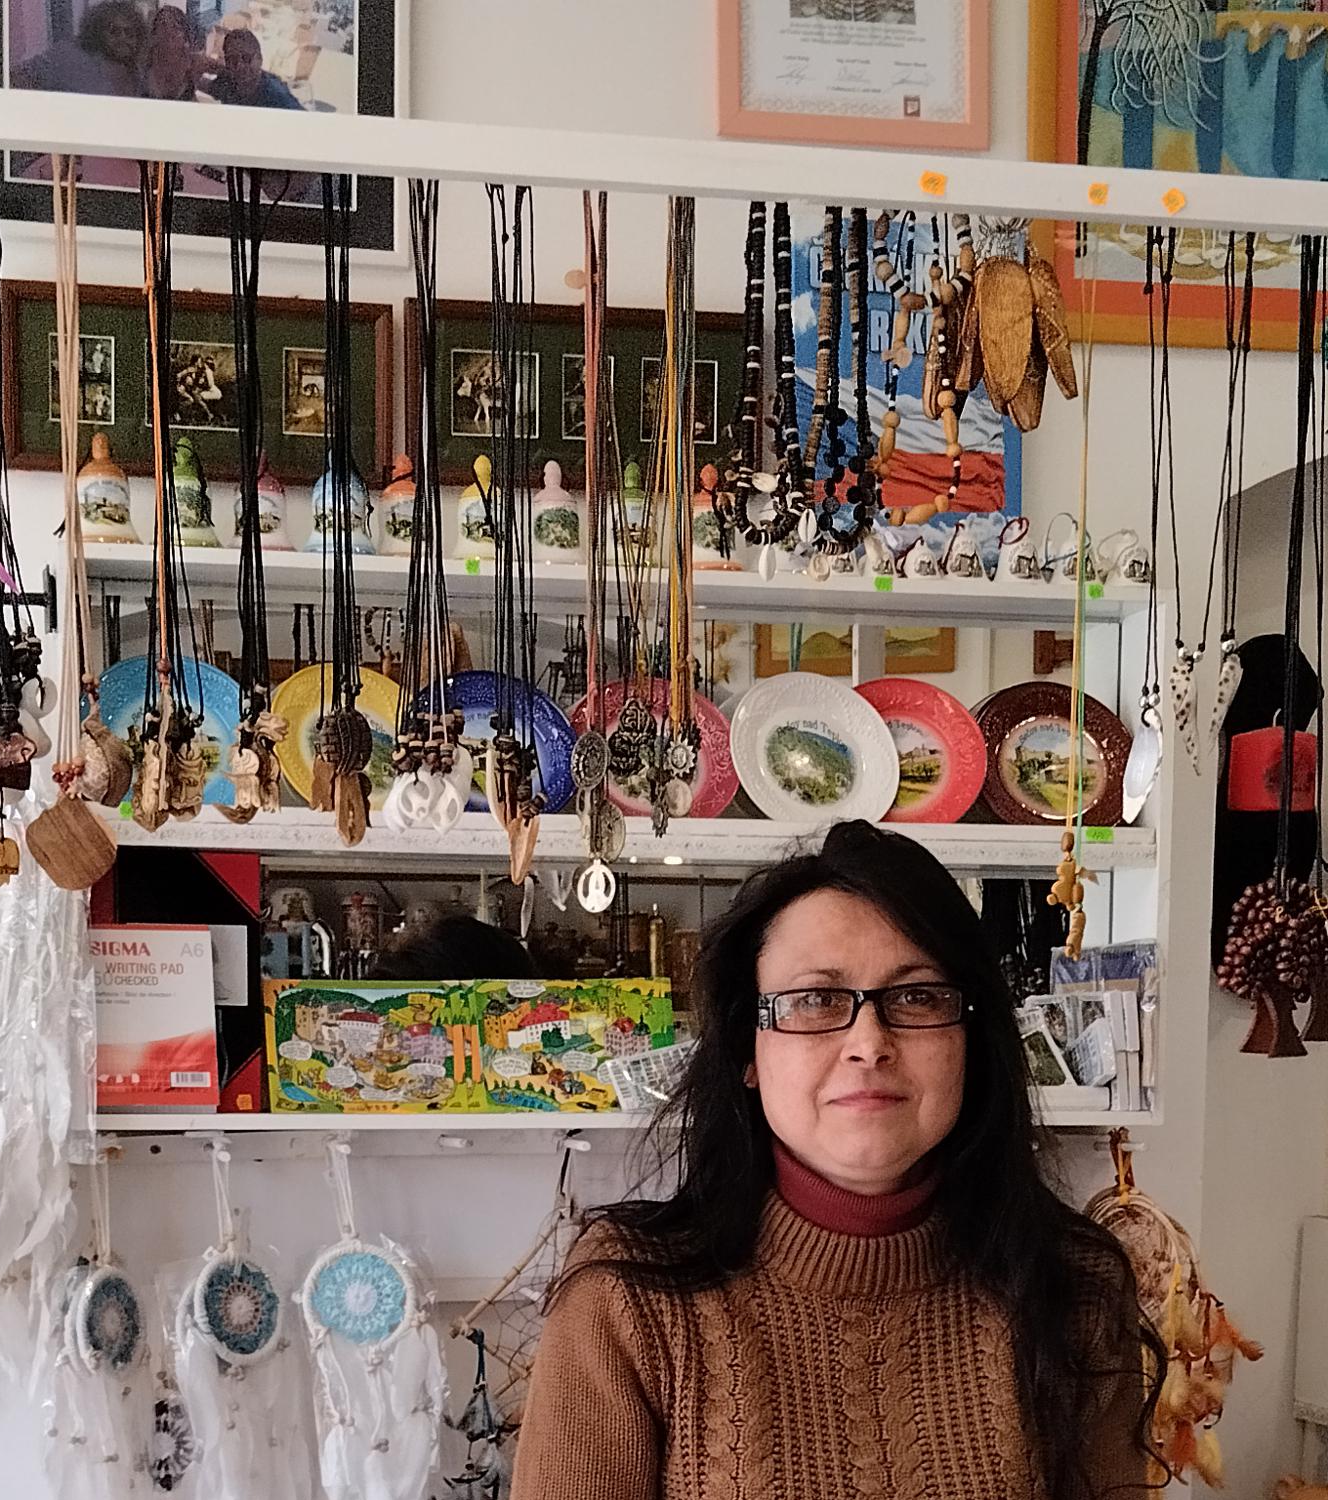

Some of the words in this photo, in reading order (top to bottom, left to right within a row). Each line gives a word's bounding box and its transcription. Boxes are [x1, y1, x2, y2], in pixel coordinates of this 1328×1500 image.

[89, 941, 151, 956] SIGMA
[180, 943, 204, 957] A6
[105, 962, 157, 975] WRITING
[160, 963, 184, 975] PAD
[114, 976, 159, 985] CHECKED
